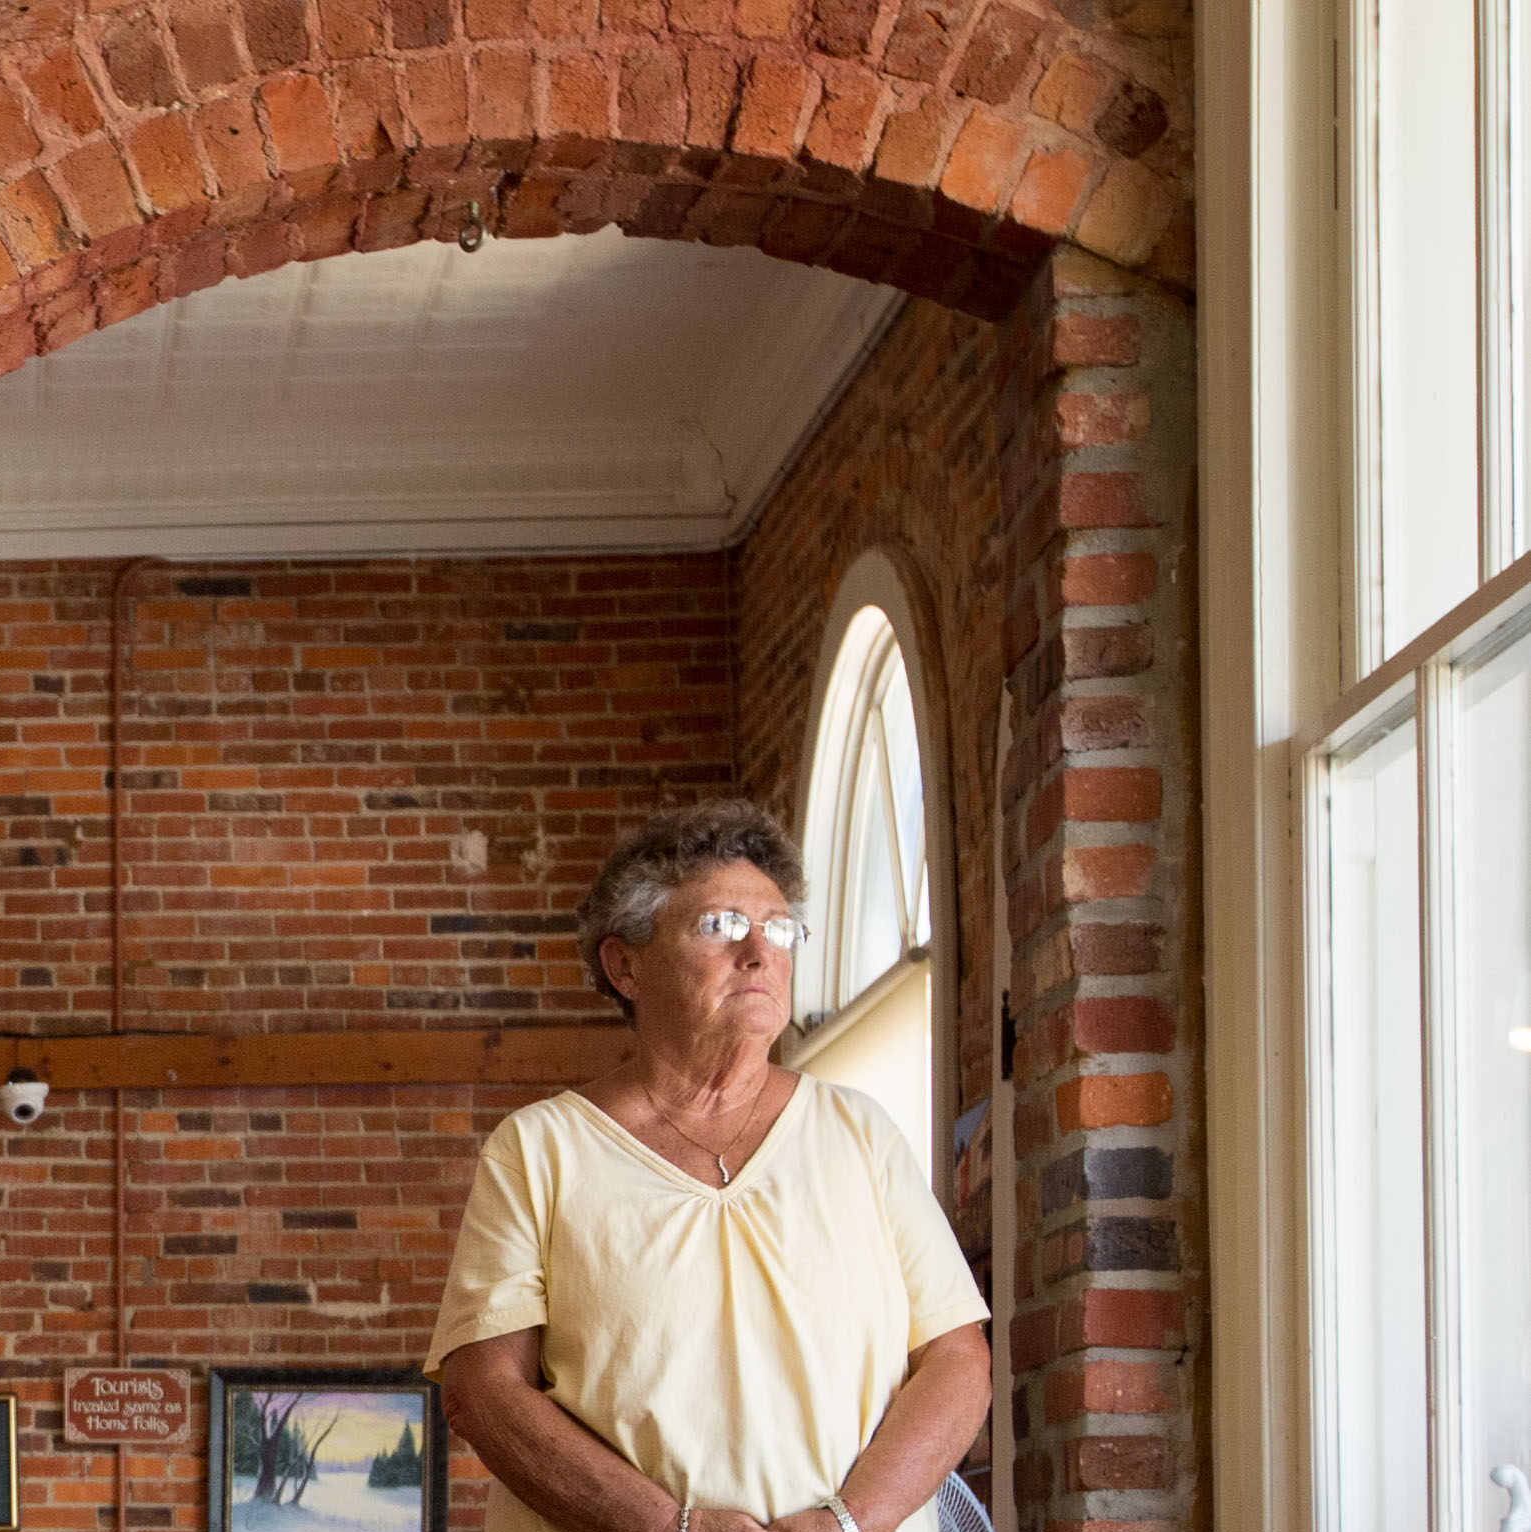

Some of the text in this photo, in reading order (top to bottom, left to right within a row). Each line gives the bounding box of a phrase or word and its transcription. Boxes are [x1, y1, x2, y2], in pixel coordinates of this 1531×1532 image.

[90, 1377, 164, 1400] Tourists
[73, 1399, 182, 1416] treated same as
[86, 1415, 170, 1434] Home Folks
